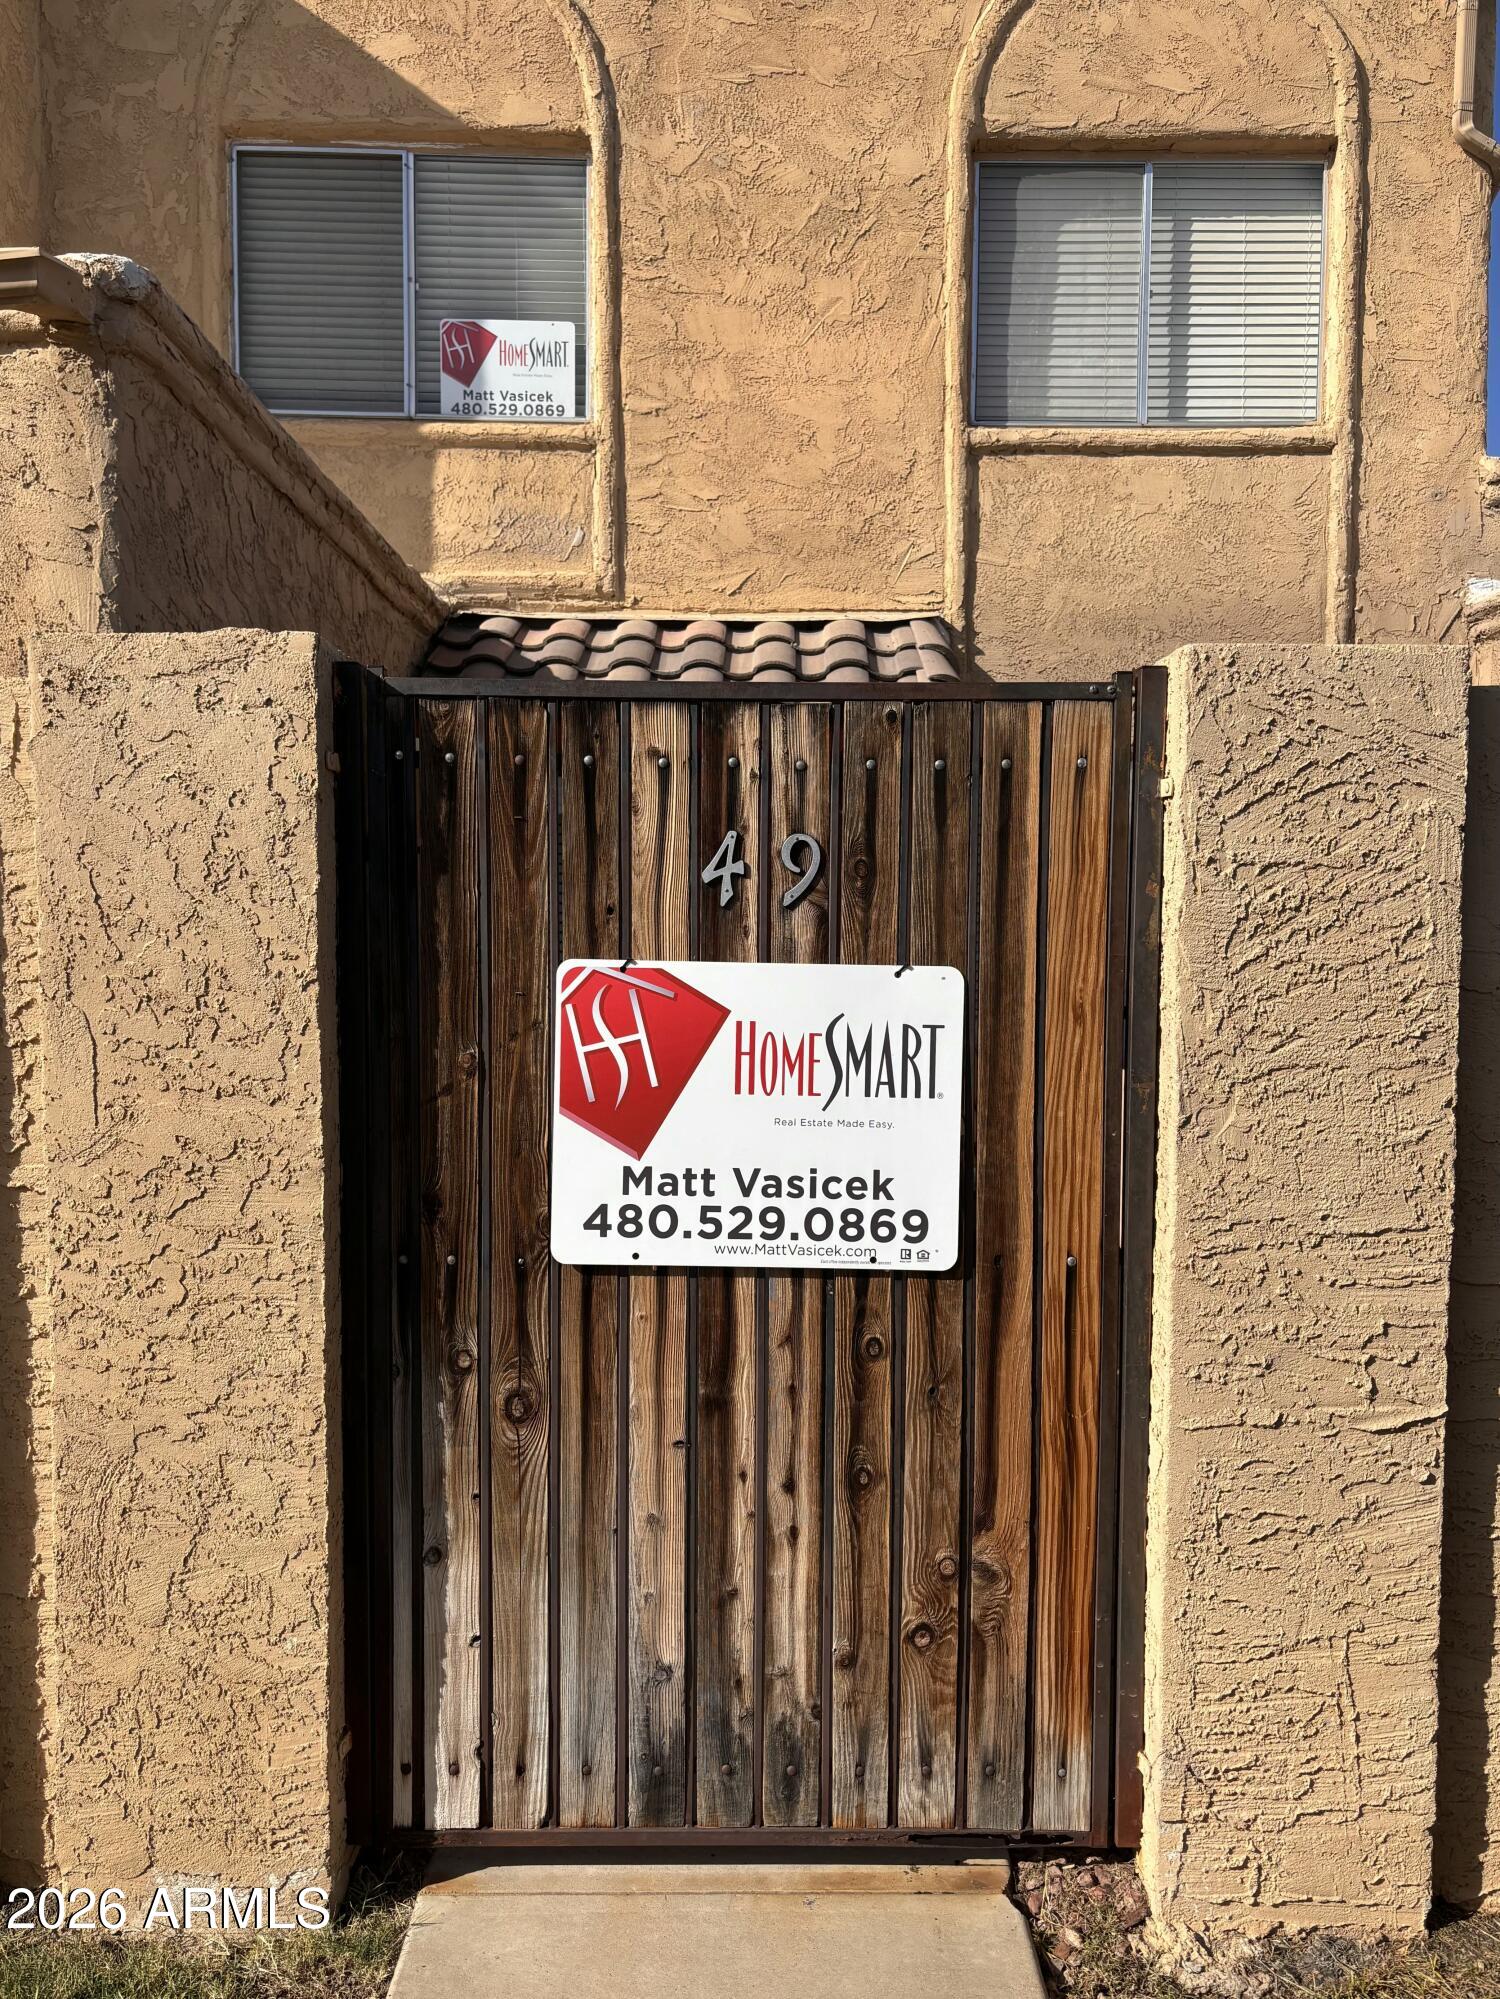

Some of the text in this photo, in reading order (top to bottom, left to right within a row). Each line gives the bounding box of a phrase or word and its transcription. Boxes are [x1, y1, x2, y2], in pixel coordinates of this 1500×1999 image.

[463, 389, 553, 402] Matt Vasicek
[451, 402, 565, 417] 480.529.0869
[773, 1117, 895, 1130] Real Estate Made Easy.
[622, 1165, 895, 1201] Matt Vasicek
[582, 1203, 930, 1244] 480.529.0869
[714, 1243, 877, 1258] www.MattVasicek.com
